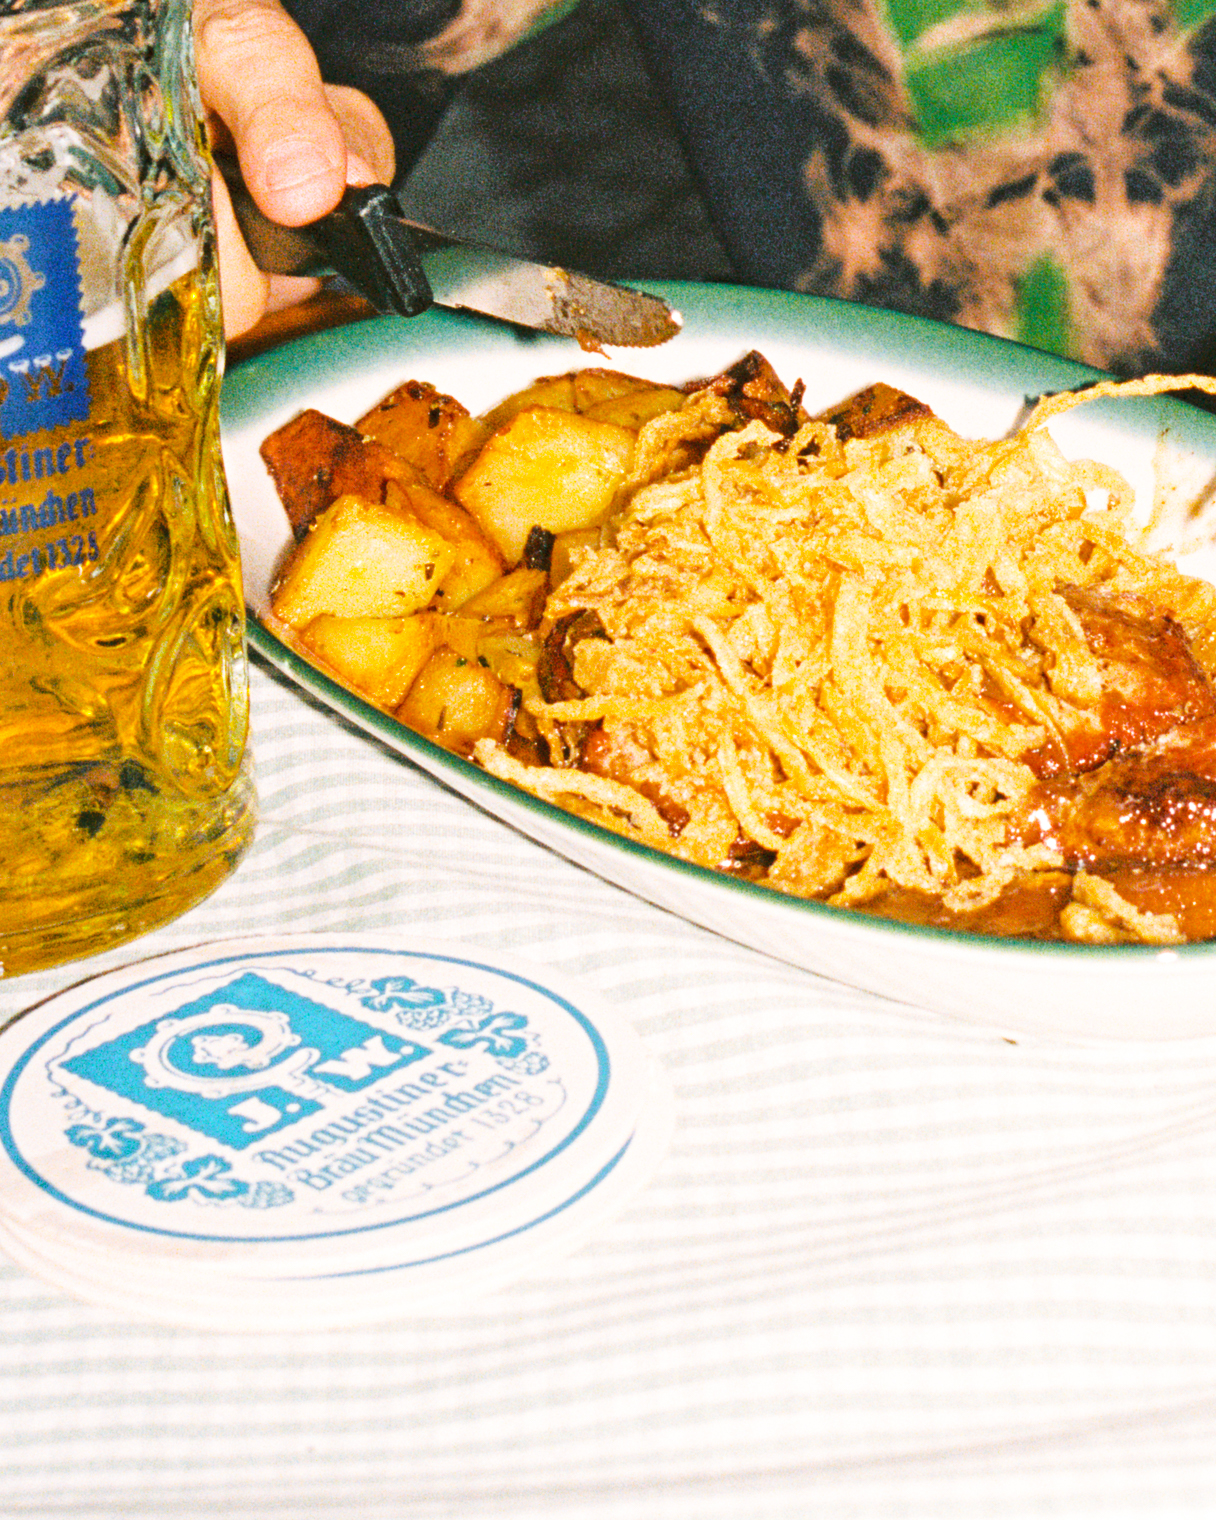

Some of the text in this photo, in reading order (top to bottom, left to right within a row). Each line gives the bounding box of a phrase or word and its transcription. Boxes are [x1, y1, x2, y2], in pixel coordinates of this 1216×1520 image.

[0, 488, 98, 537] ünchen
[45, 530, 99, 570] 1328
[287, 1073, 523, 1191] Bräu München
[470, 1091, 545, 1129] 1328
